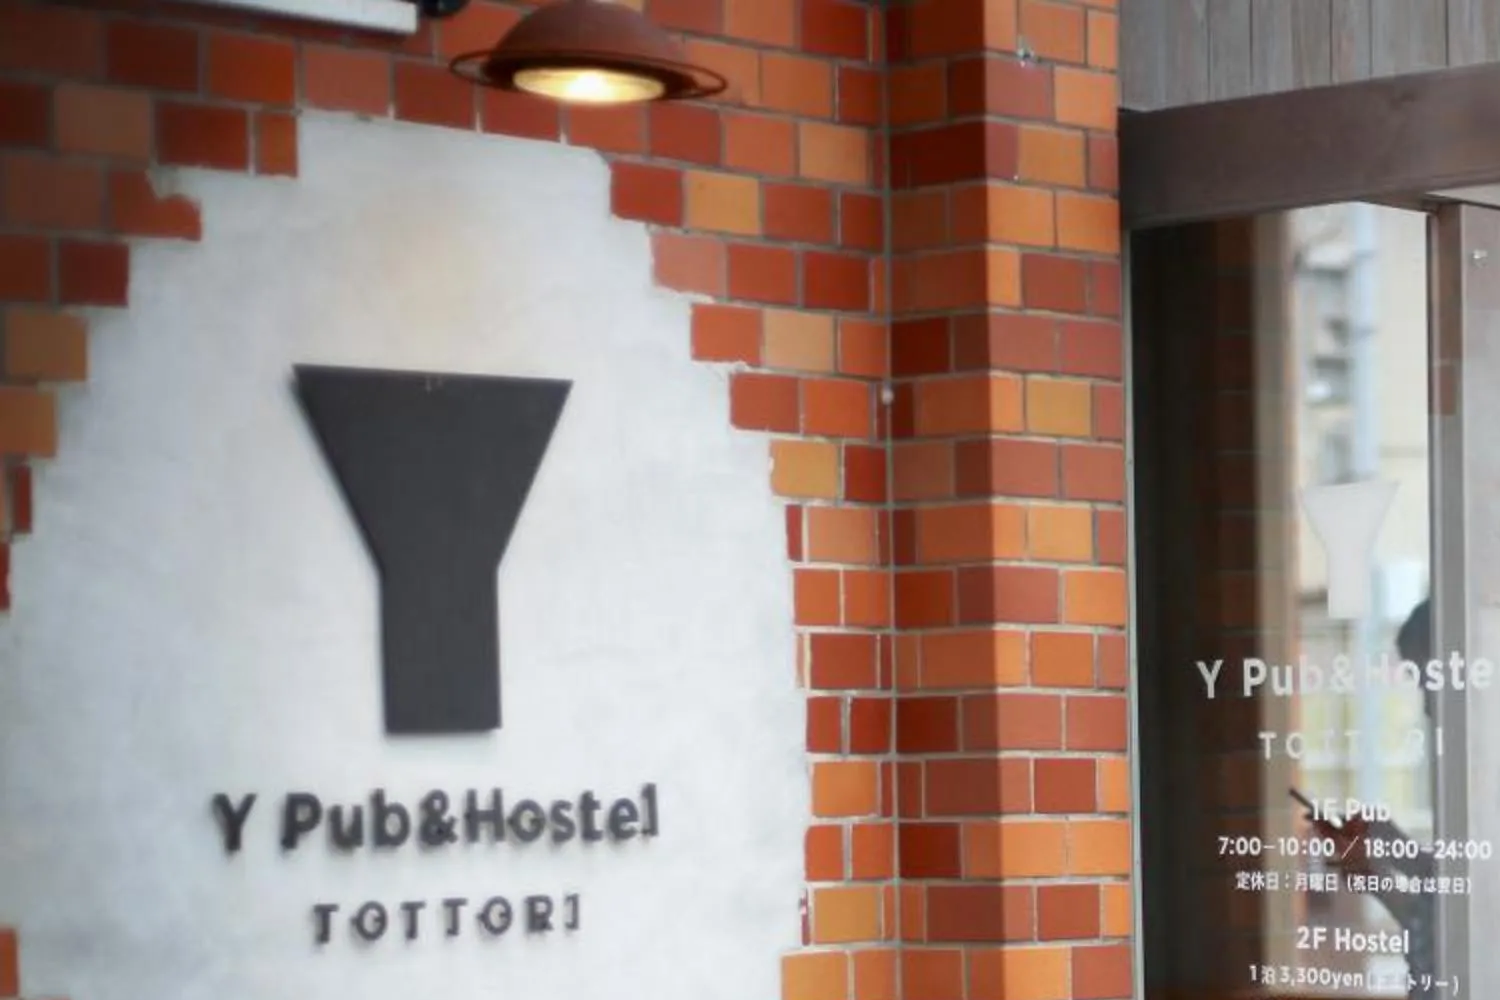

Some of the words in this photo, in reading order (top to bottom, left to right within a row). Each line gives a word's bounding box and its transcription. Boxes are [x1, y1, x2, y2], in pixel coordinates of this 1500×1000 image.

[1195, 658, 1224, 700] Y
[212, 792, 259, 853] Y
[280, 783, 660, 851] Pub&Hostel
[1310, 797, 1339, 822] 1F
[1345, 797, 1392, 823] Pub
[312, 893, 581, 943] TOTTORI
[1295, 926, 1328, 950] 2F
[1334, 928, 1410, 954] Hostel
